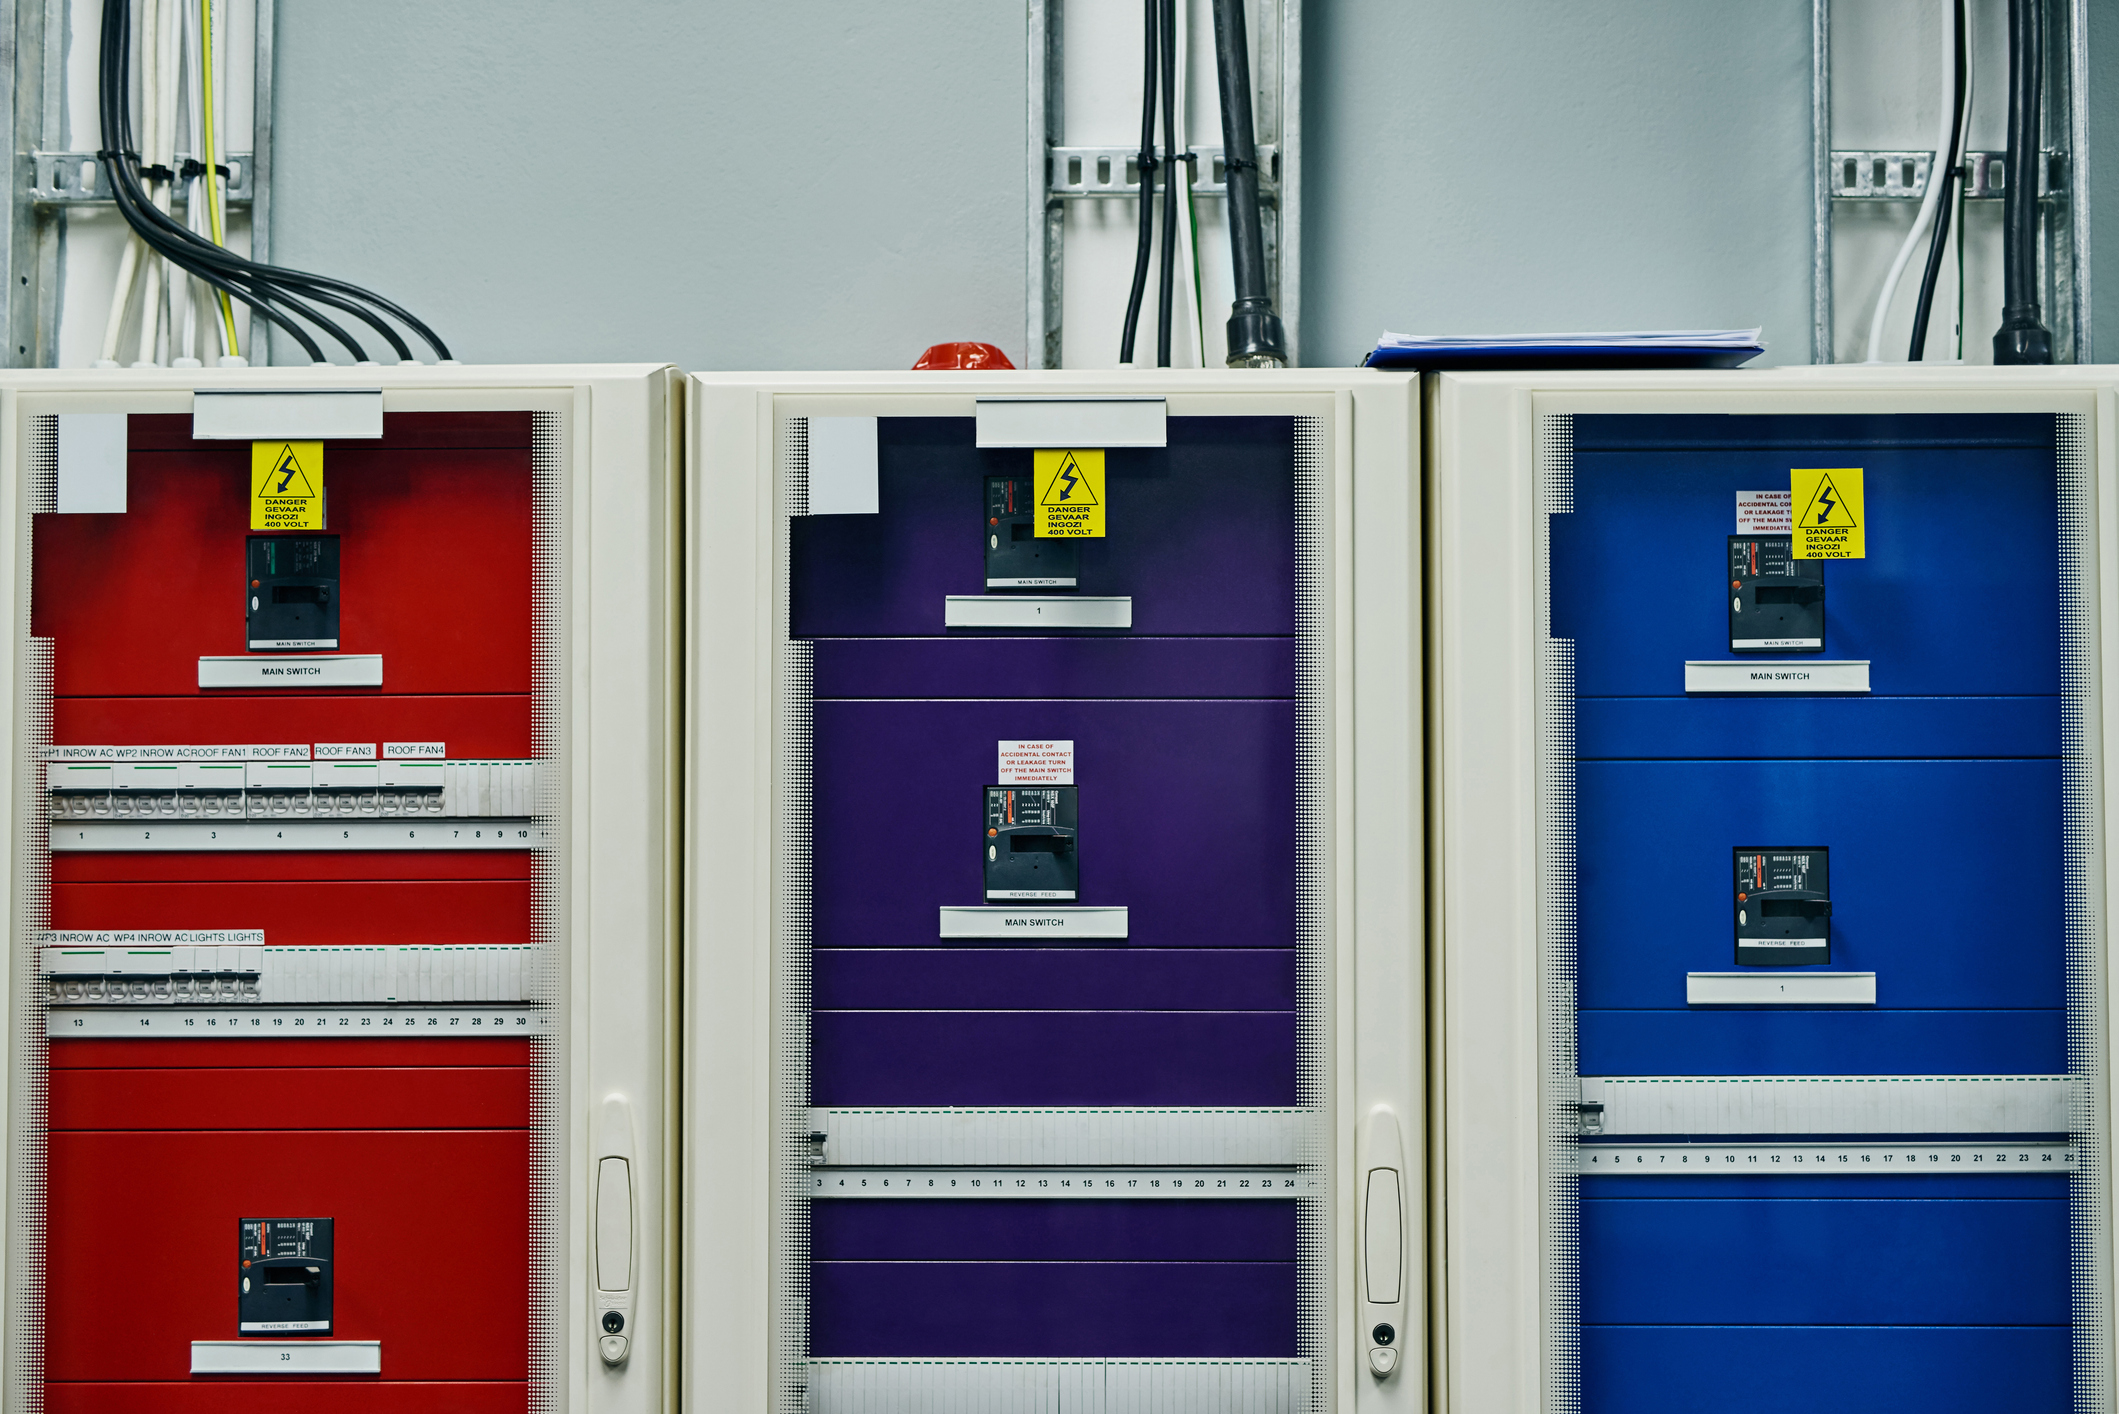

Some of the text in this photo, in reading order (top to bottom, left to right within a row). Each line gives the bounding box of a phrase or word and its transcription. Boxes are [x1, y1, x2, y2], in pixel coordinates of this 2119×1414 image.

[64, 749, 97, 757] INROW
[100, 749, 113, 757] AC
[116, 749, 190, 757] WP2 INROW AC
[191, 748, 219, 757] ROOF
[253, 748, 308, 756] ROOF FAN2
[315, 747, 371, 755] ROOF FAN3
[388, 746, 444, 754] ROOF FAN4
[60, 934, 93, 942] INROW
[96, 934, 110, 942] AC
[114, 933, 188, 942] WP4 INROW AC
[190, 933, 225, 942] LIGHTS
[228, 933, 263, 941] LIGHTS
